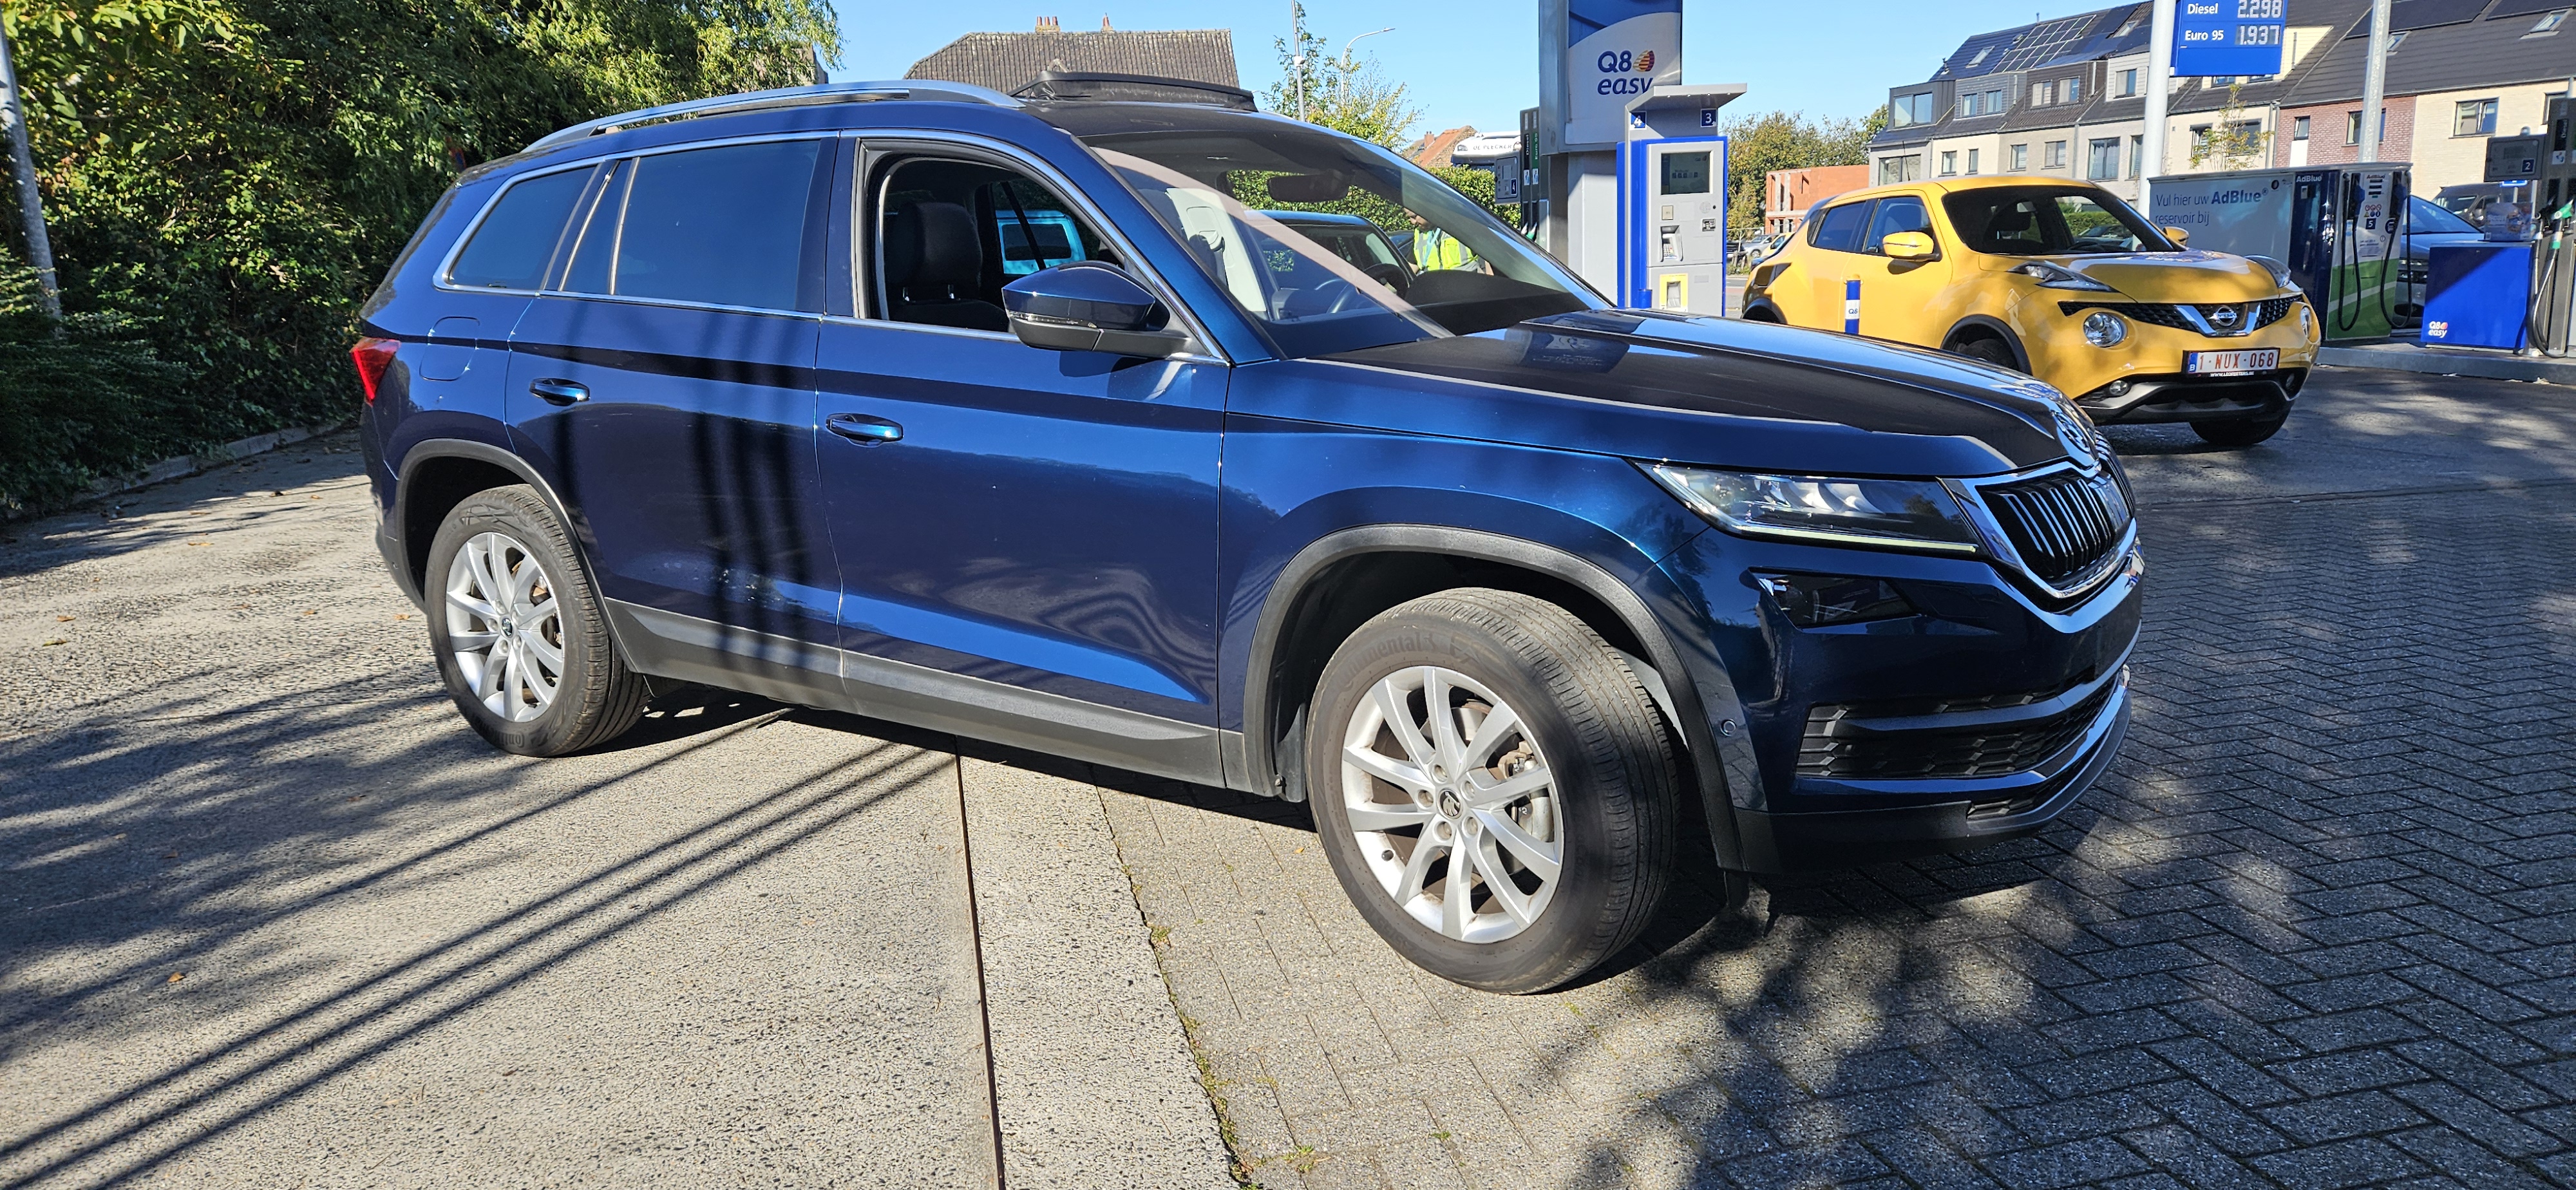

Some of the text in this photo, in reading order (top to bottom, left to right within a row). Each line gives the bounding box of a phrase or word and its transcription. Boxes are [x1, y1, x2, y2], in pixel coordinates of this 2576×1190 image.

[2187, 0, 2282, 18] Diesel 2.298
[2184, 25, 2280, 45] Euro 95 1.937
[1598, 50, 1632, 73] Q8
[1633, 115, 1643, 126] 4
[1705, 113, 1712, 124] 3
[2525, 162, 2531, 171] 2
[2156, 194, 2171, 207] Vul
[2174, 194, 2191, 205] hier
[2194, 196, 2209, 205] uw
[2155, 211, 2210, 226] reservoir bij
[2429, 321, 2441, 329] Q8
[2428, 329, 2447, 338] easy
